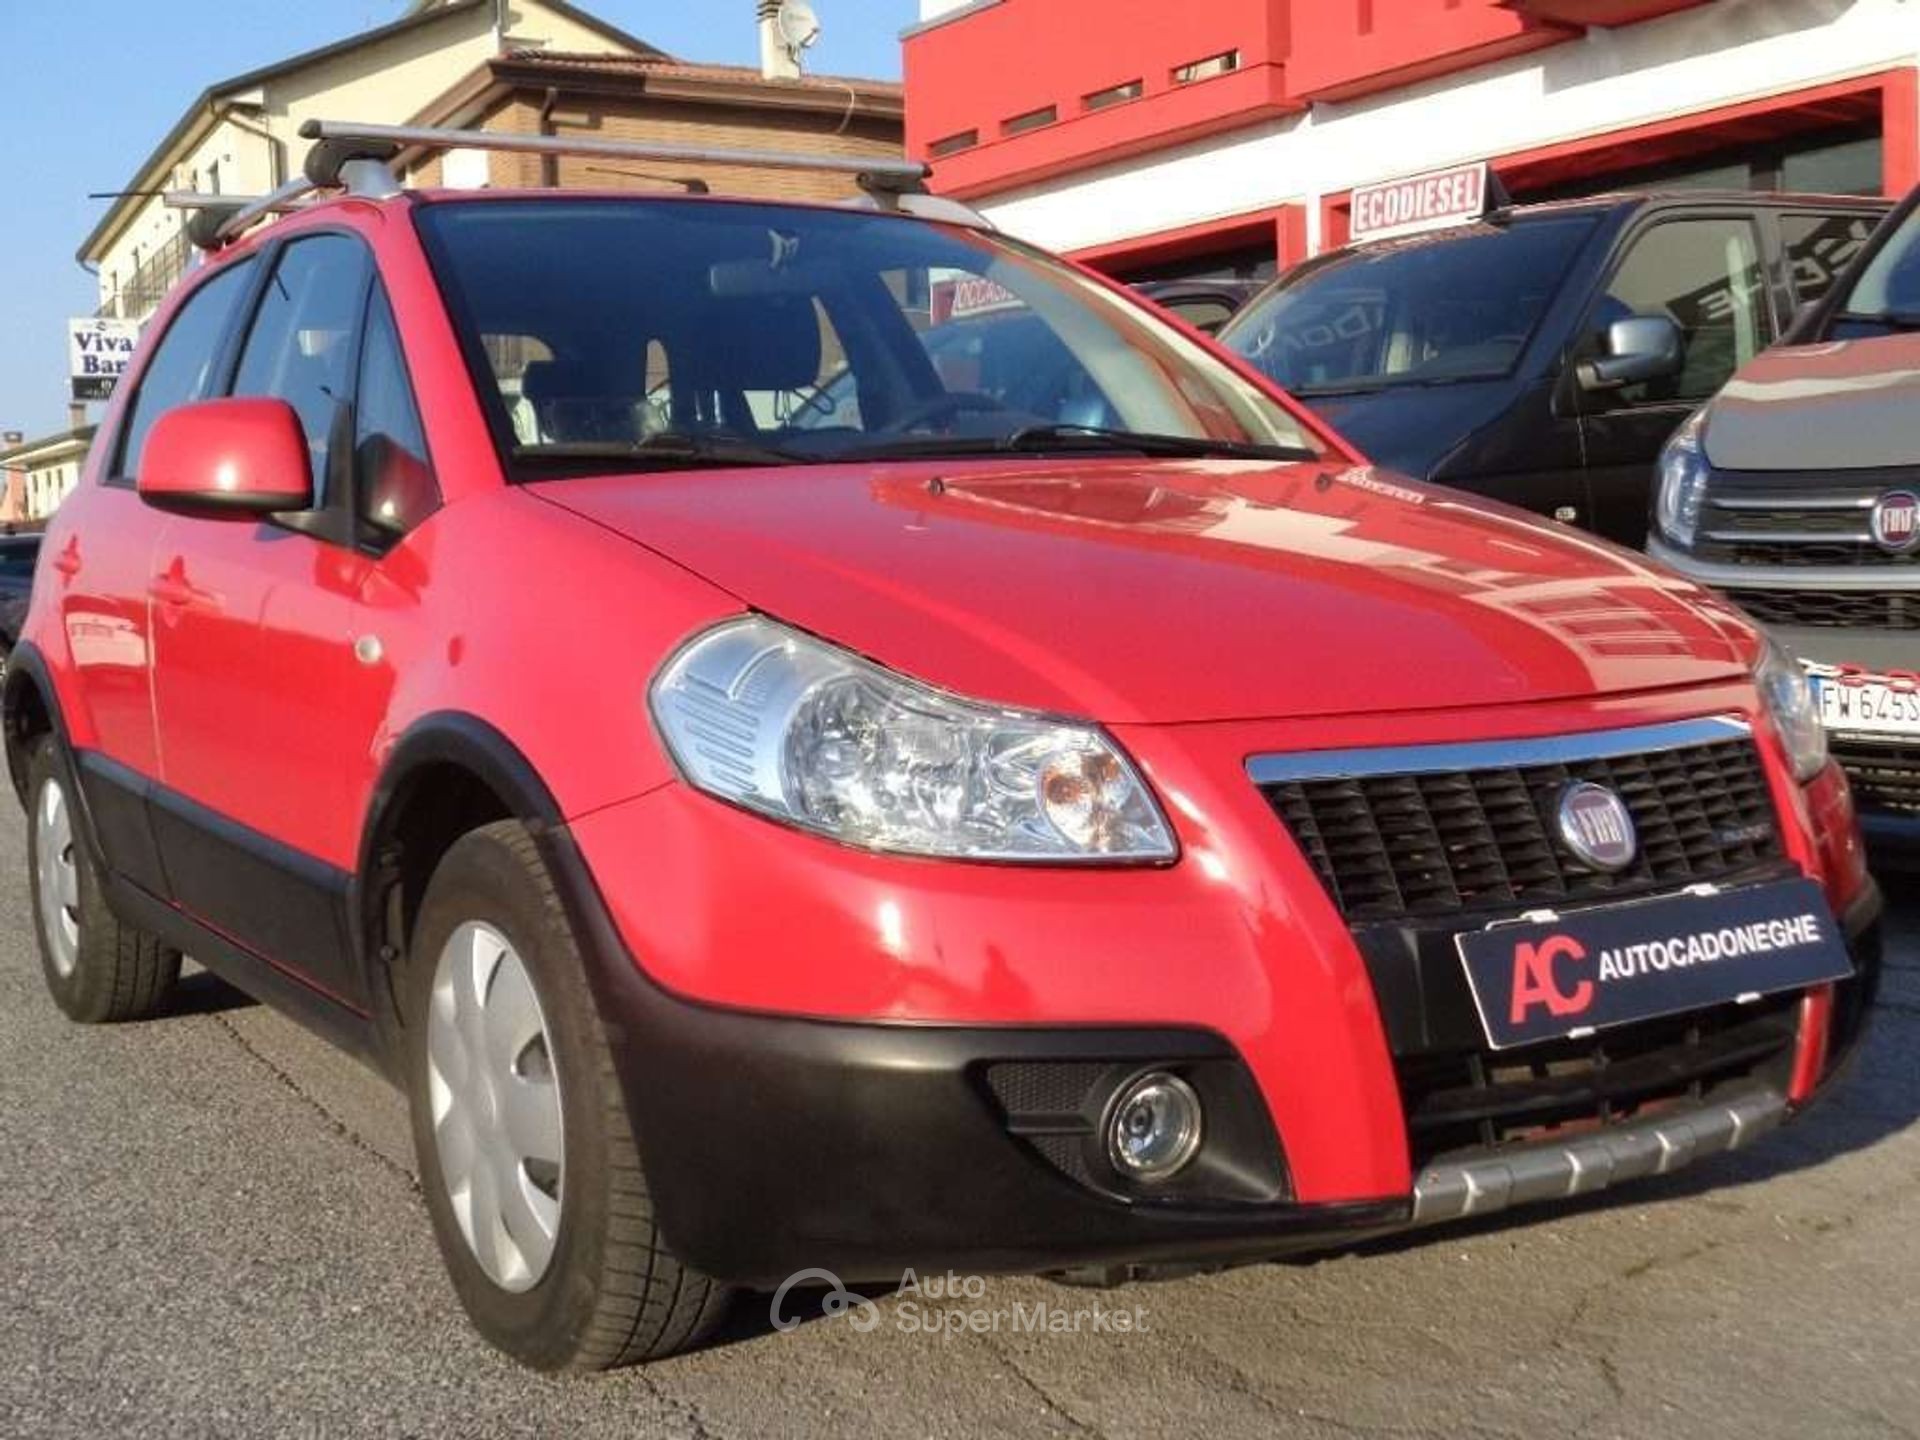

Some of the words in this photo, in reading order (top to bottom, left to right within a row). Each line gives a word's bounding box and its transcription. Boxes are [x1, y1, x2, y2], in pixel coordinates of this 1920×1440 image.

[1355, 171, 1478, 230] ECODIESEL
[74, 332, 135, 351] Viva
[83, 355, 127, 373] Bar
[1882, 506, 1914, 533] FIAT
[1823, 687, 1850, 717] FW
[1575, 804, 1622, 846] FIAT
[1509, 934, 1594, 1025] AC
[1599, 913, 1822, 982] AUTOCADONEGHE
